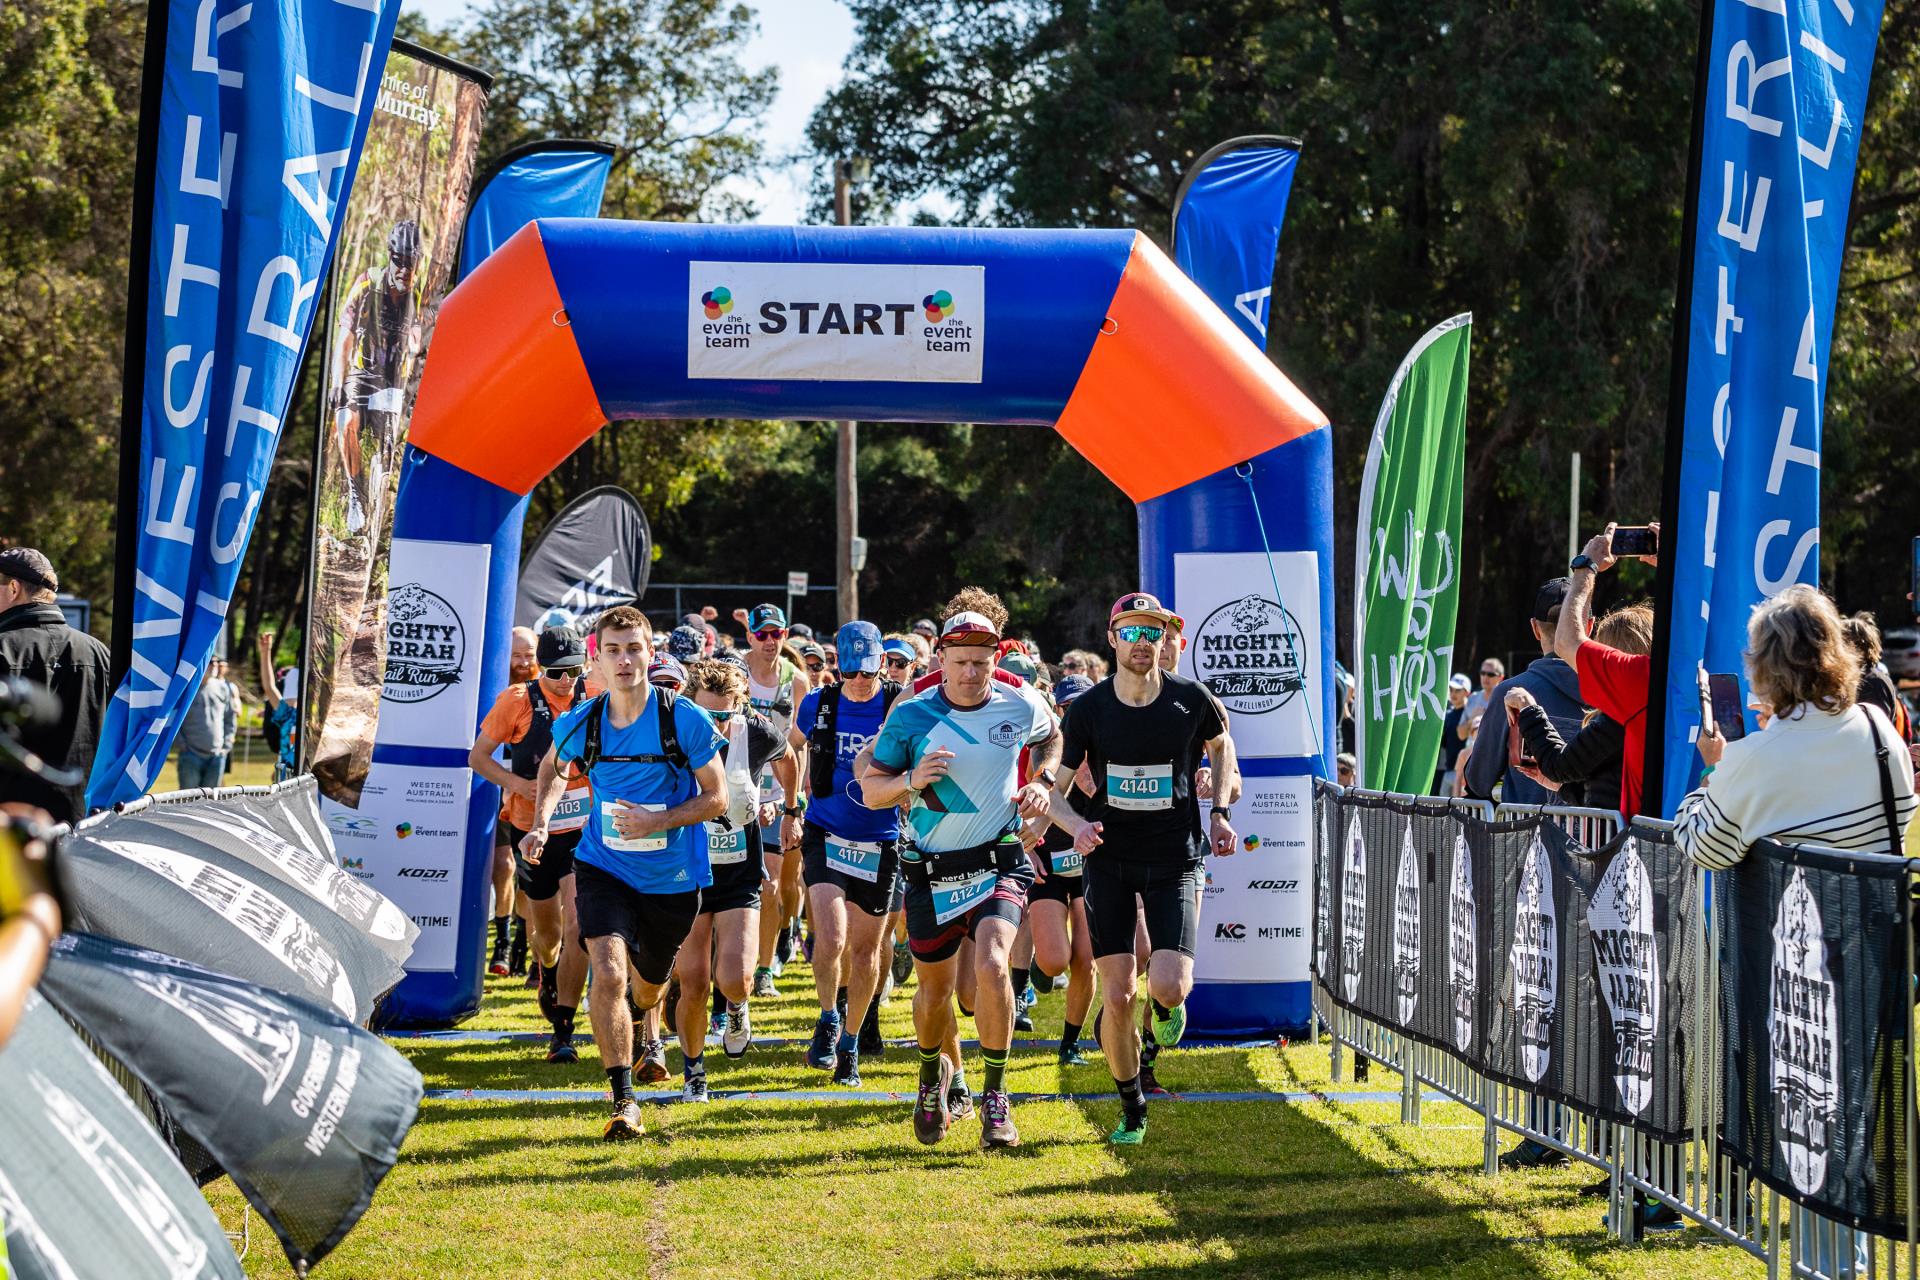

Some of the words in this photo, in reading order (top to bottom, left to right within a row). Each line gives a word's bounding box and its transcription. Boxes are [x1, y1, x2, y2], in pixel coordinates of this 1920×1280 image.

[413, 85, 428, 105] of
[376, 88, 441, 131] Murray
[727, 315, 742, 323] the
[758, 301, 915, 336] START
[948, 318, 963, 327] the
[702, 322, 751, 335] event
[923, 325, 972, 339] event
[705, 335, 750, 348] team
[926, 339, 970, 352] team
[388, 621, 457, 642] GHTY
[1203, 633, 1297, 652] MIGHTY
[388, 641, 456, 661] RRAH
[1203, 652, 1298, 669] JARRAH
[384, 667, 404, 682] ail
[408, 667, 439, 684] Run
[1215, 678, 1253, 694] Trail
[1255, 678, 1286, 694] Run
[1234, 698, 1273, 709] DWELLINGUP
[406, 789, 454, 798] AUSTRALIA
[1120, 779, 1158, 793] 4140
[552, 800, 581, 816] 4103
[709, 834, 737, 849] 029
[1263, 840, 1286, 848] event
[838, 847, 867, 865] 4117
[398, 868, 449, 879] KODA
[941, 873, 965, 882] nerd
[949, 881, 983, 903] 4127
[1248, 880, 1298, 889] KODA
[1215, 923, 1246, 939] KC
[1591, 929, 1653, 971] MIGHT
